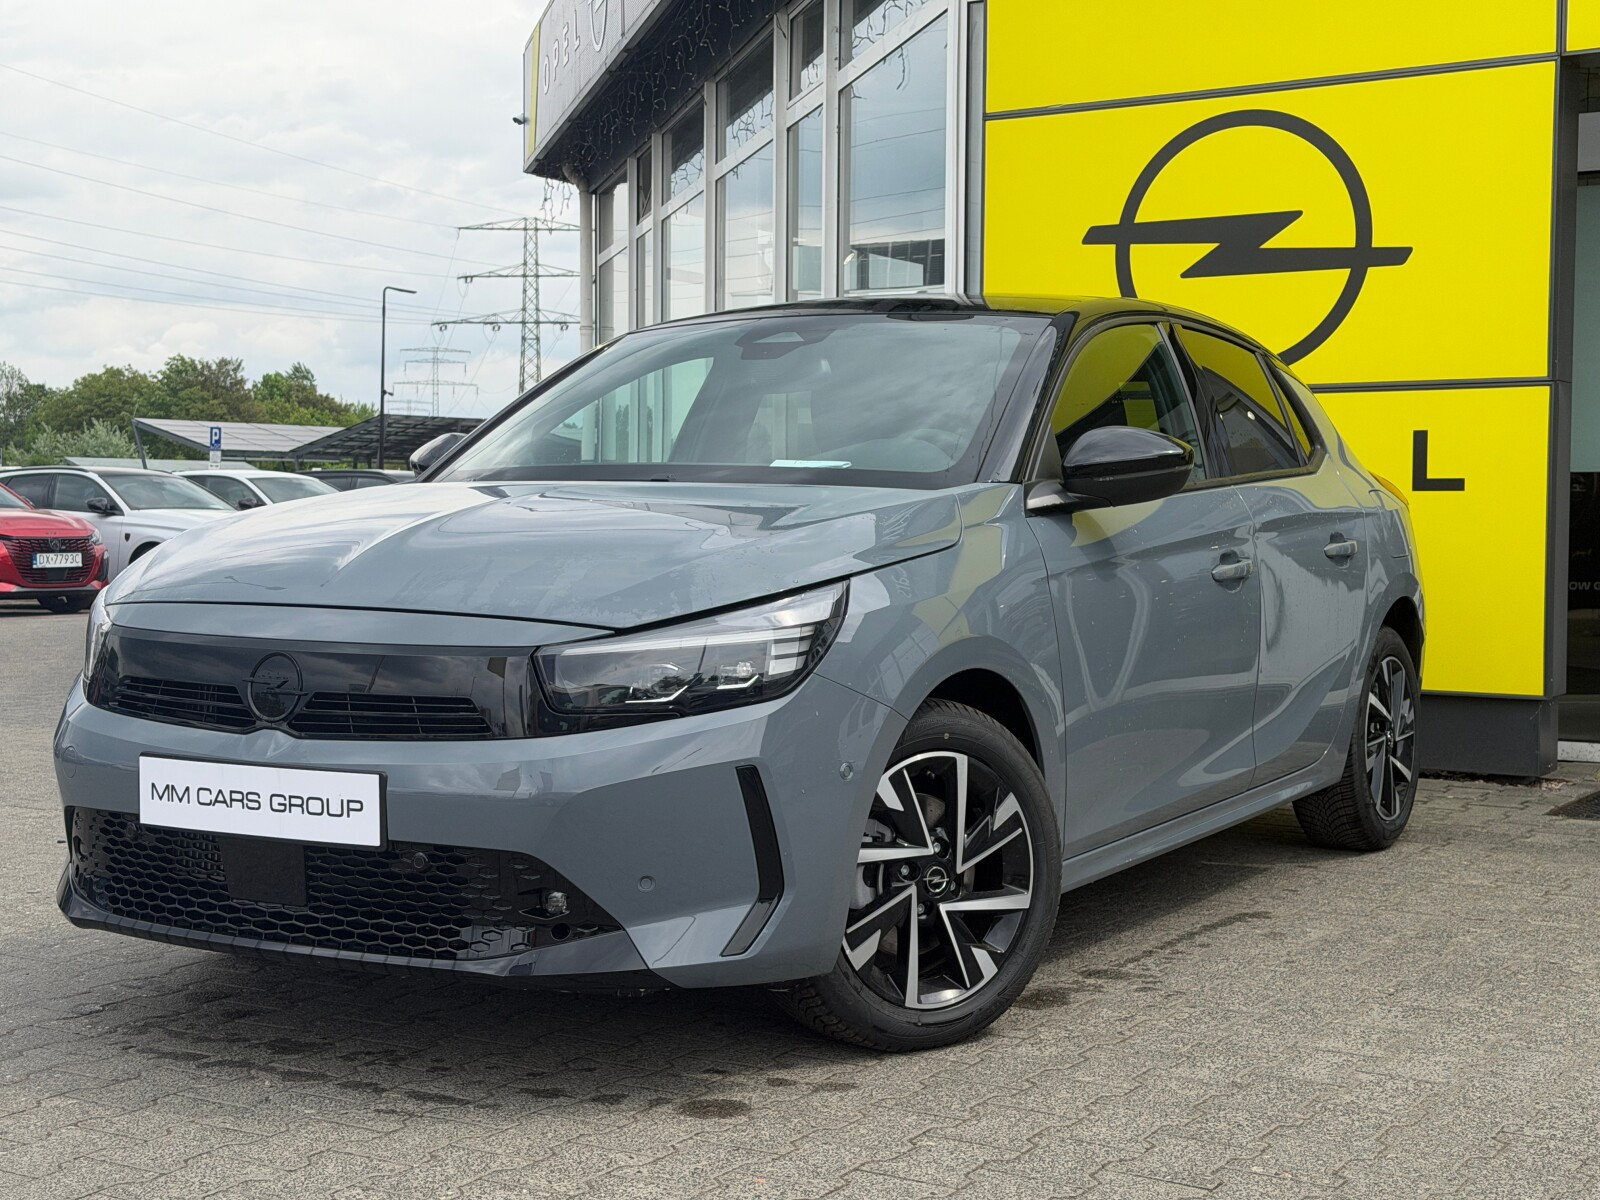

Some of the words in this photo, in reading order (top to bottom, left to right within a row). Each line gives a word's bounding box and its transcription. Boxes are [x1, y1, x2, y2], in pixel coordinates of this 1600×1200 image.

[543, 8, 580, 95] OPEL
[212, 428, 220, 444] P
[39, 554, 51, 565] DX
[54, 553, 80, 564] 7793C
[151, 782, 191, 805] MM
[196, 787, 262, 811] CARS
[269, 793, 364, 818] GROUP
